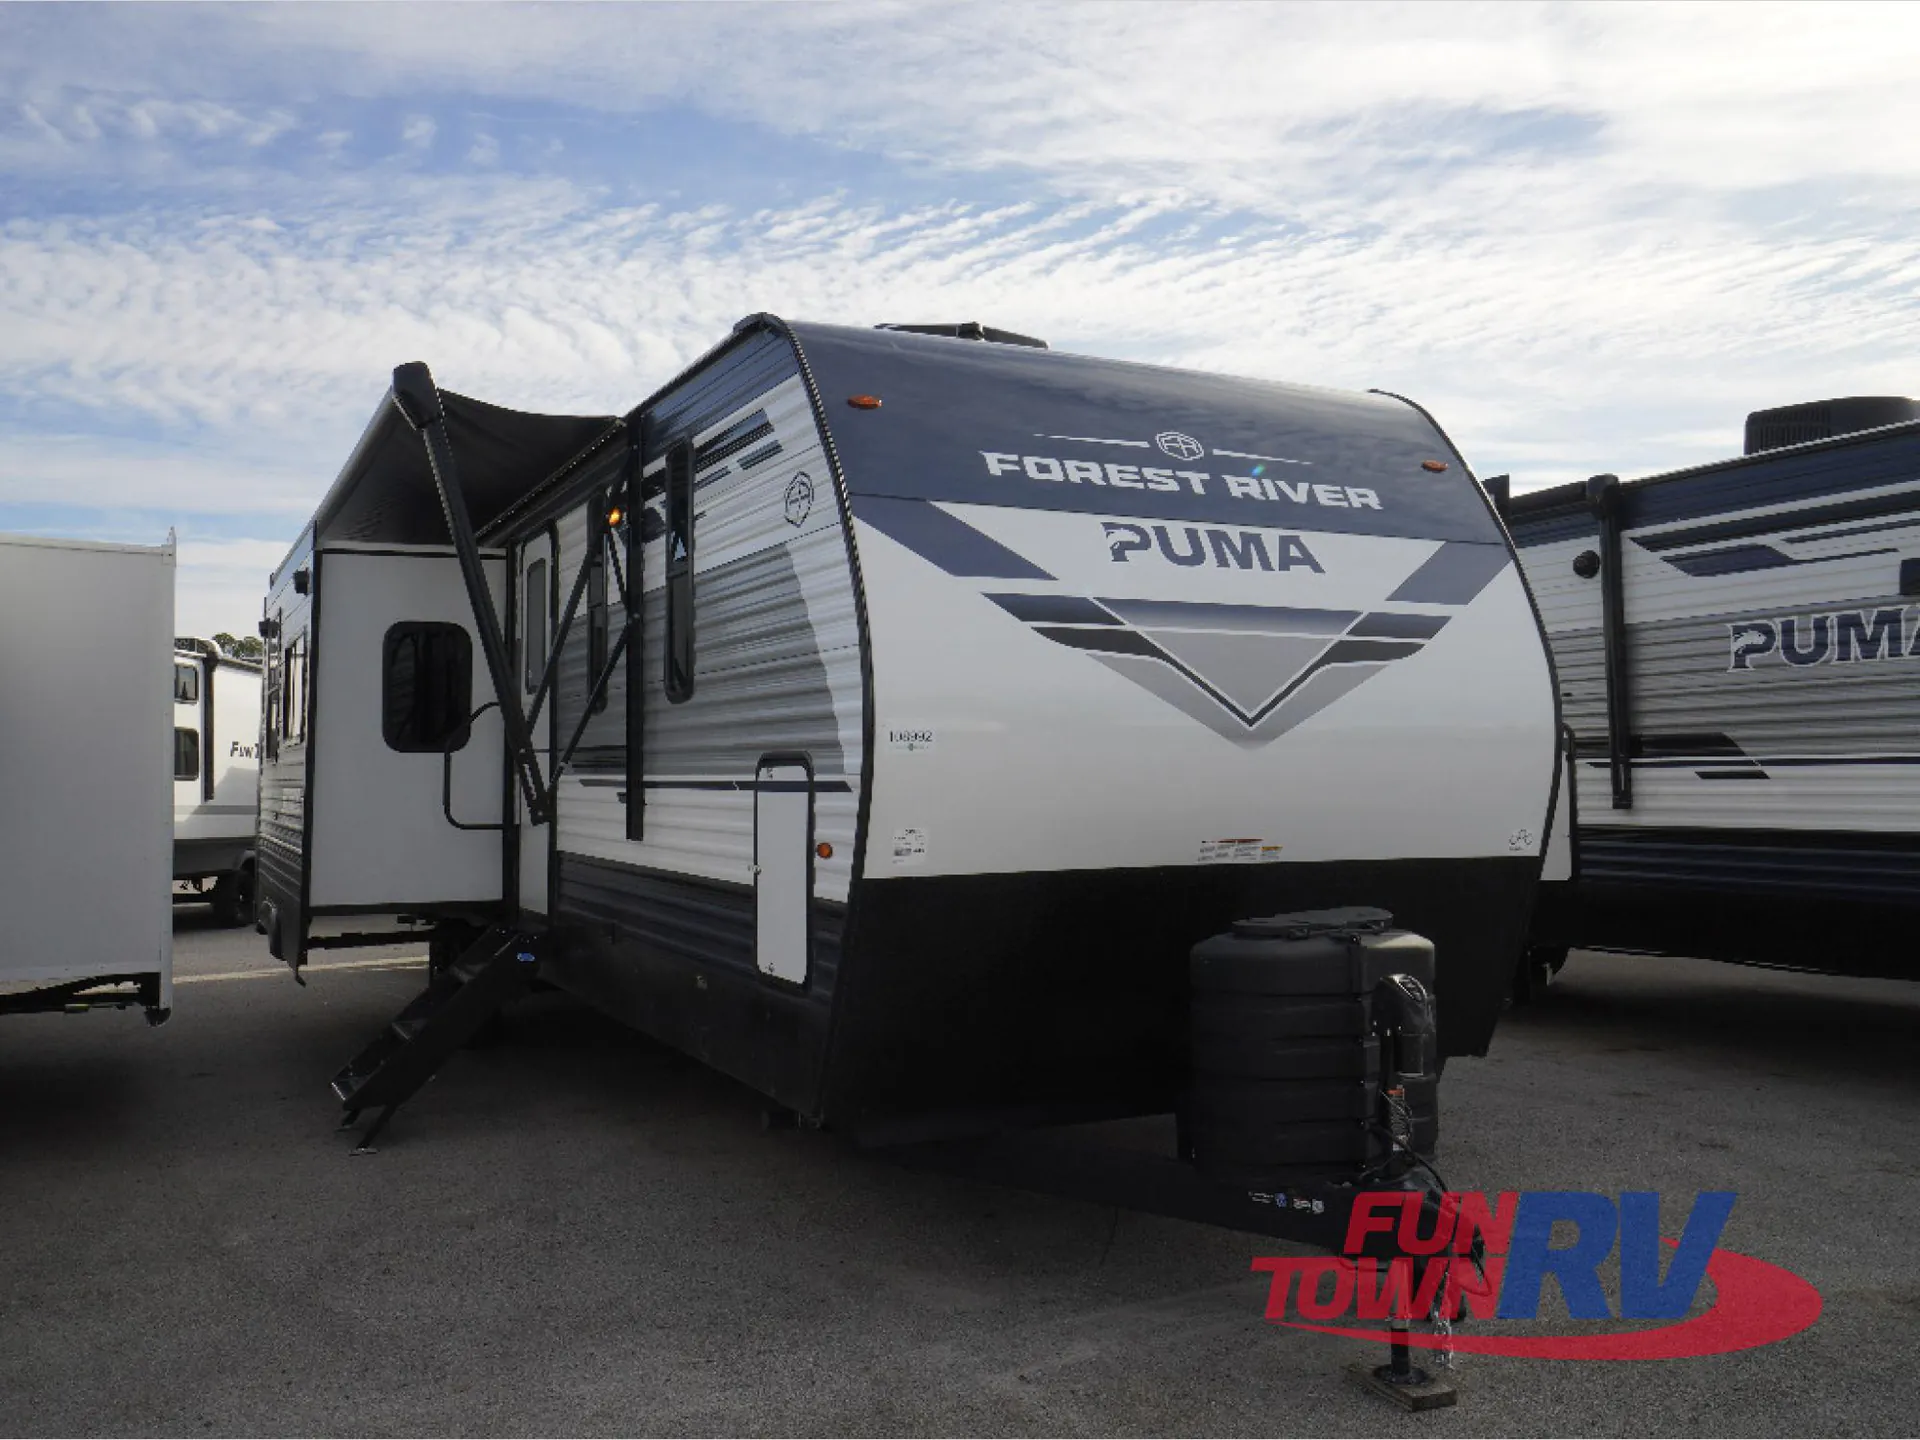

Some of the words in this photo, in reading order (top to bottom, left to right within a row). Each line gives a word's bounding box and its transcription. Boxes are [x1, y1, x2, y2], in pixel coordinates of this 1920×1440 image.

[979, 450, 1210, 495] FOREST
[1222, 473, 1384, 510] RIVER
[1100, 522, 1326, 573] PUMA
[1726, 603, 1920, 673] PUM
